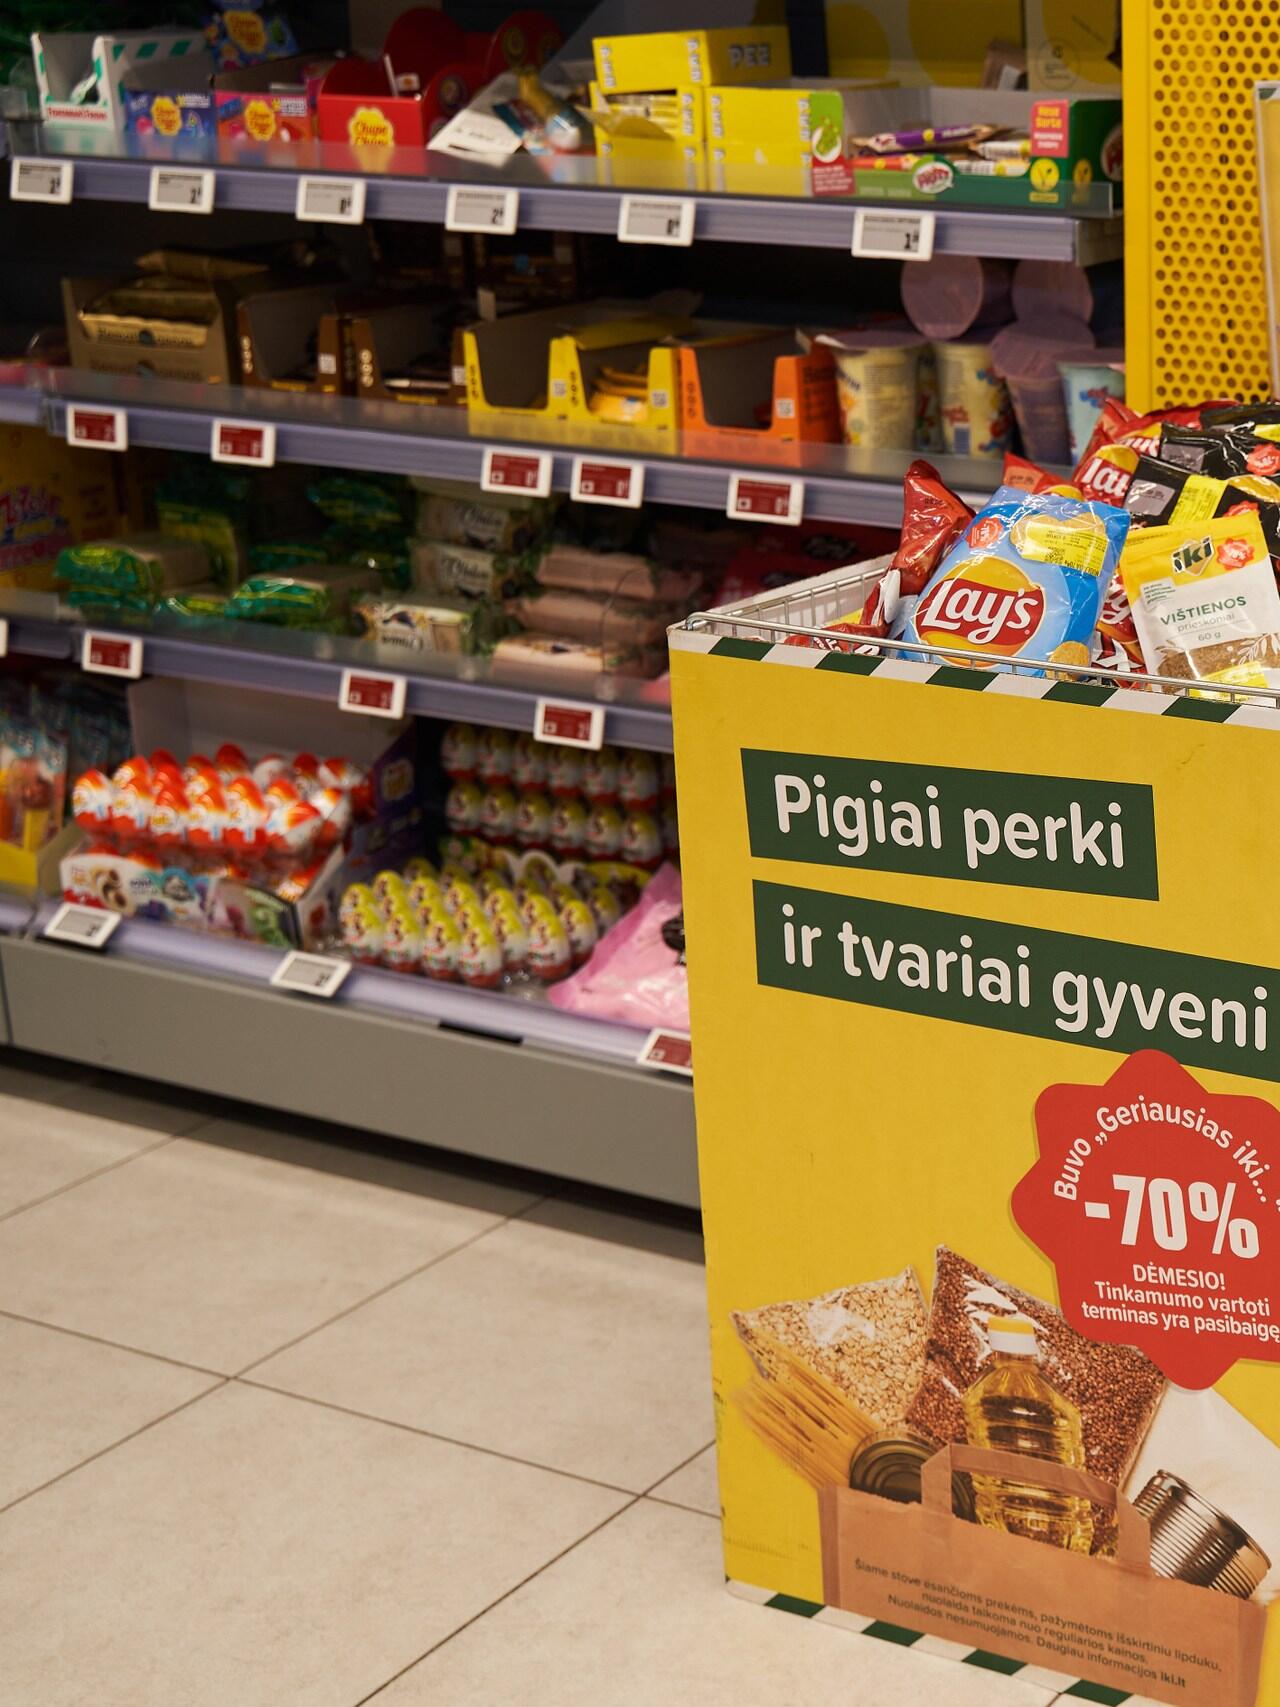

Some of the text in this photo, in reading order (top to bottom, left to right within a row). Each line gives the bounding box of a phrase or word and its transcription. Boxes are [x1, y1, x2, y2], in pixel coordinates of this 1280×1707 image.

[1171, 536, 1213, 573] iki
[921, 579, 1040, 645] Lay's
[1160, 596, 1247, 626] VIŠTIENOS
[774, 774, 1124, 869] Pigiai perki
[782, 904, 1268, 1051] ir tvariai gyveni
[1054, 1138, 1091, 1200] Buvo
[1085, 1174, 1260, 1259] -70%
[1095, 1281, 1270, 1317] Tinkamumo vartoti
[1133, 1261, 1226, 1291] DĖMESIO!
[1082, 1302, 1158, 1325] terminas
[1163, 1312, 1189, 1331] yra
[855, 1558, 888, 1578] Šiame
[891, 1570, 921, 1587] stove
[924, 1581, 982, 1604] esančioms
[888, 1594, 943, 1619] Nuolaidos
[946, 1611, 1032, 1644] nesumuojamos.
[1036, 1636, 1085, 1660] Daugiau
[1087, 1651, 1157, 1681] informacijos
[922, 1591, 1148, 1665] nuolaida taikoma nuo reguliarios kainos.
